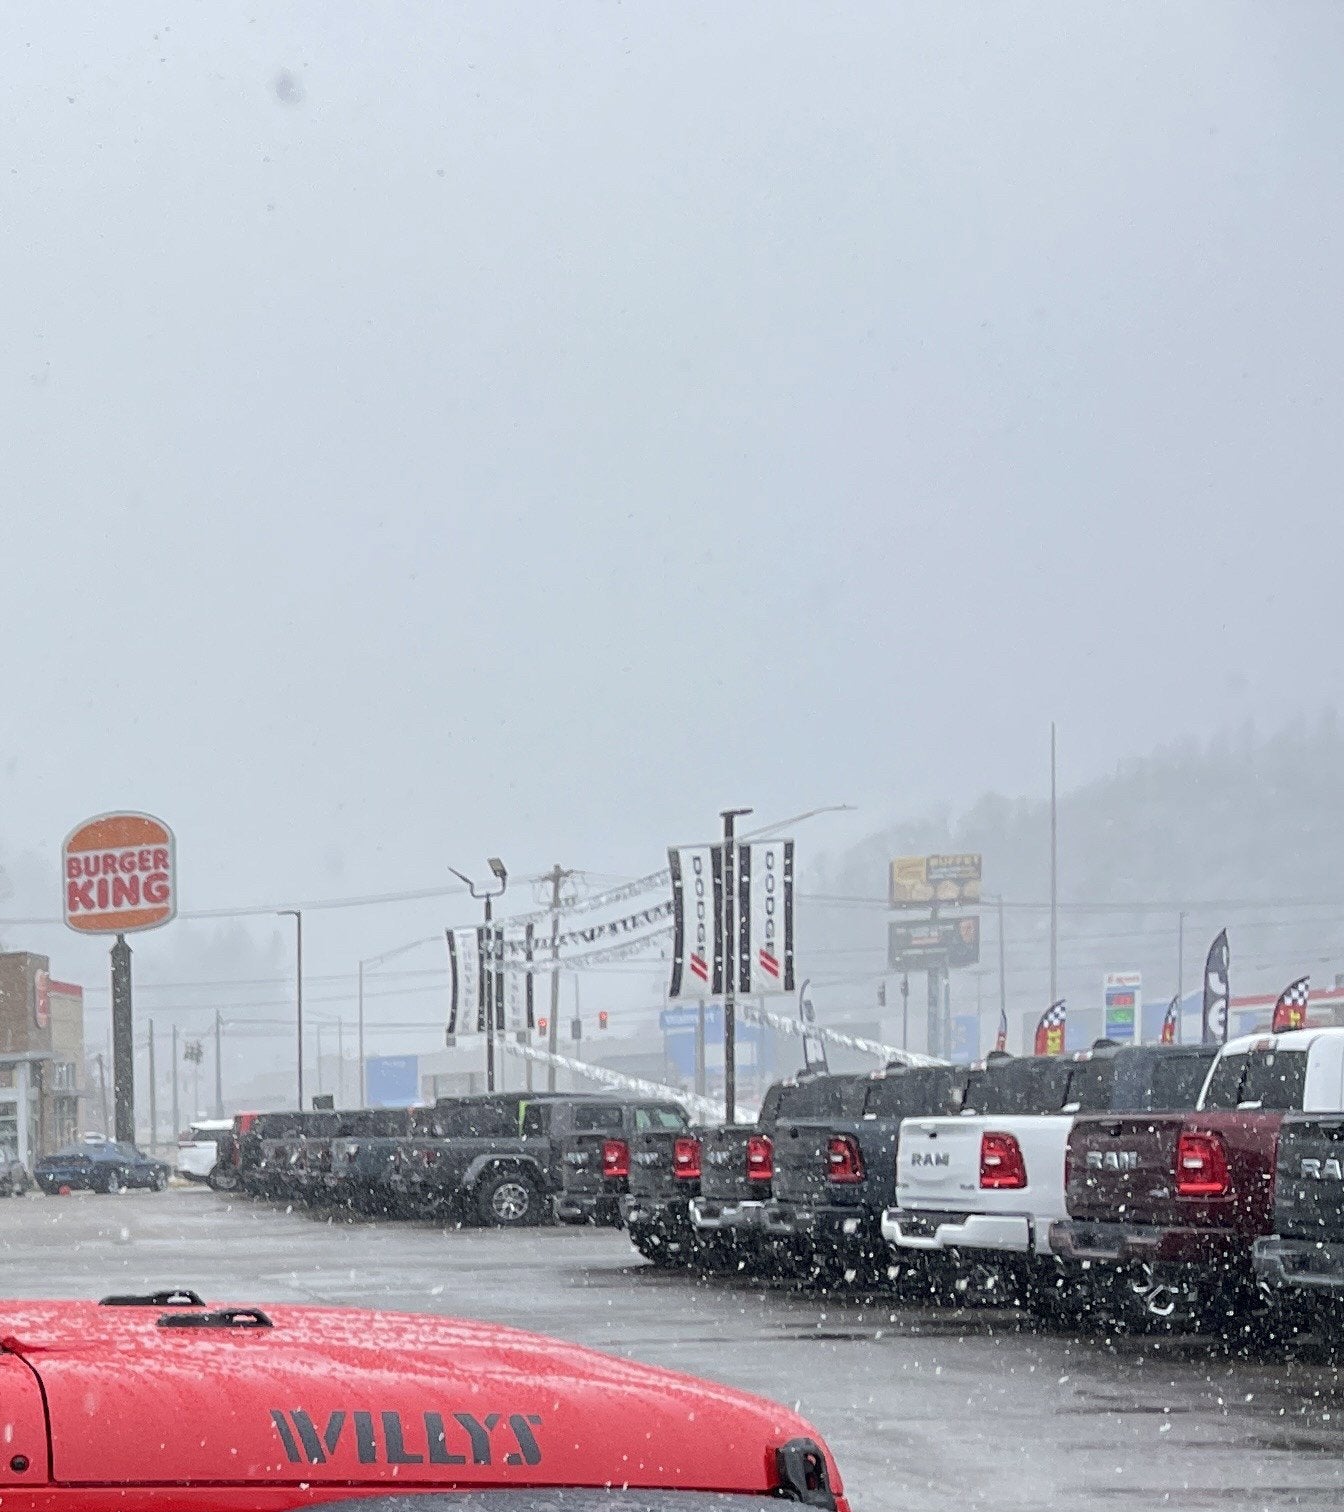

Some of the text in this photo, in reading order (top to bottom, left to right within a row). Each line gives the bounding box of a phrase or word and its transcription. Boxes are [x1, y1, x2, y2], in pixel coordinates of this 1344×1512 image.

[67, 847, 169, 879] BURGER
[68, 872, 170, 912] KING
[911, 1152, 949, 1167] RAM
[1086, 1150, 1138, 1169] RAM
[1301, 1158, 1344, 1180] RA
[269, 1409, 542, 1466] WILLYS
